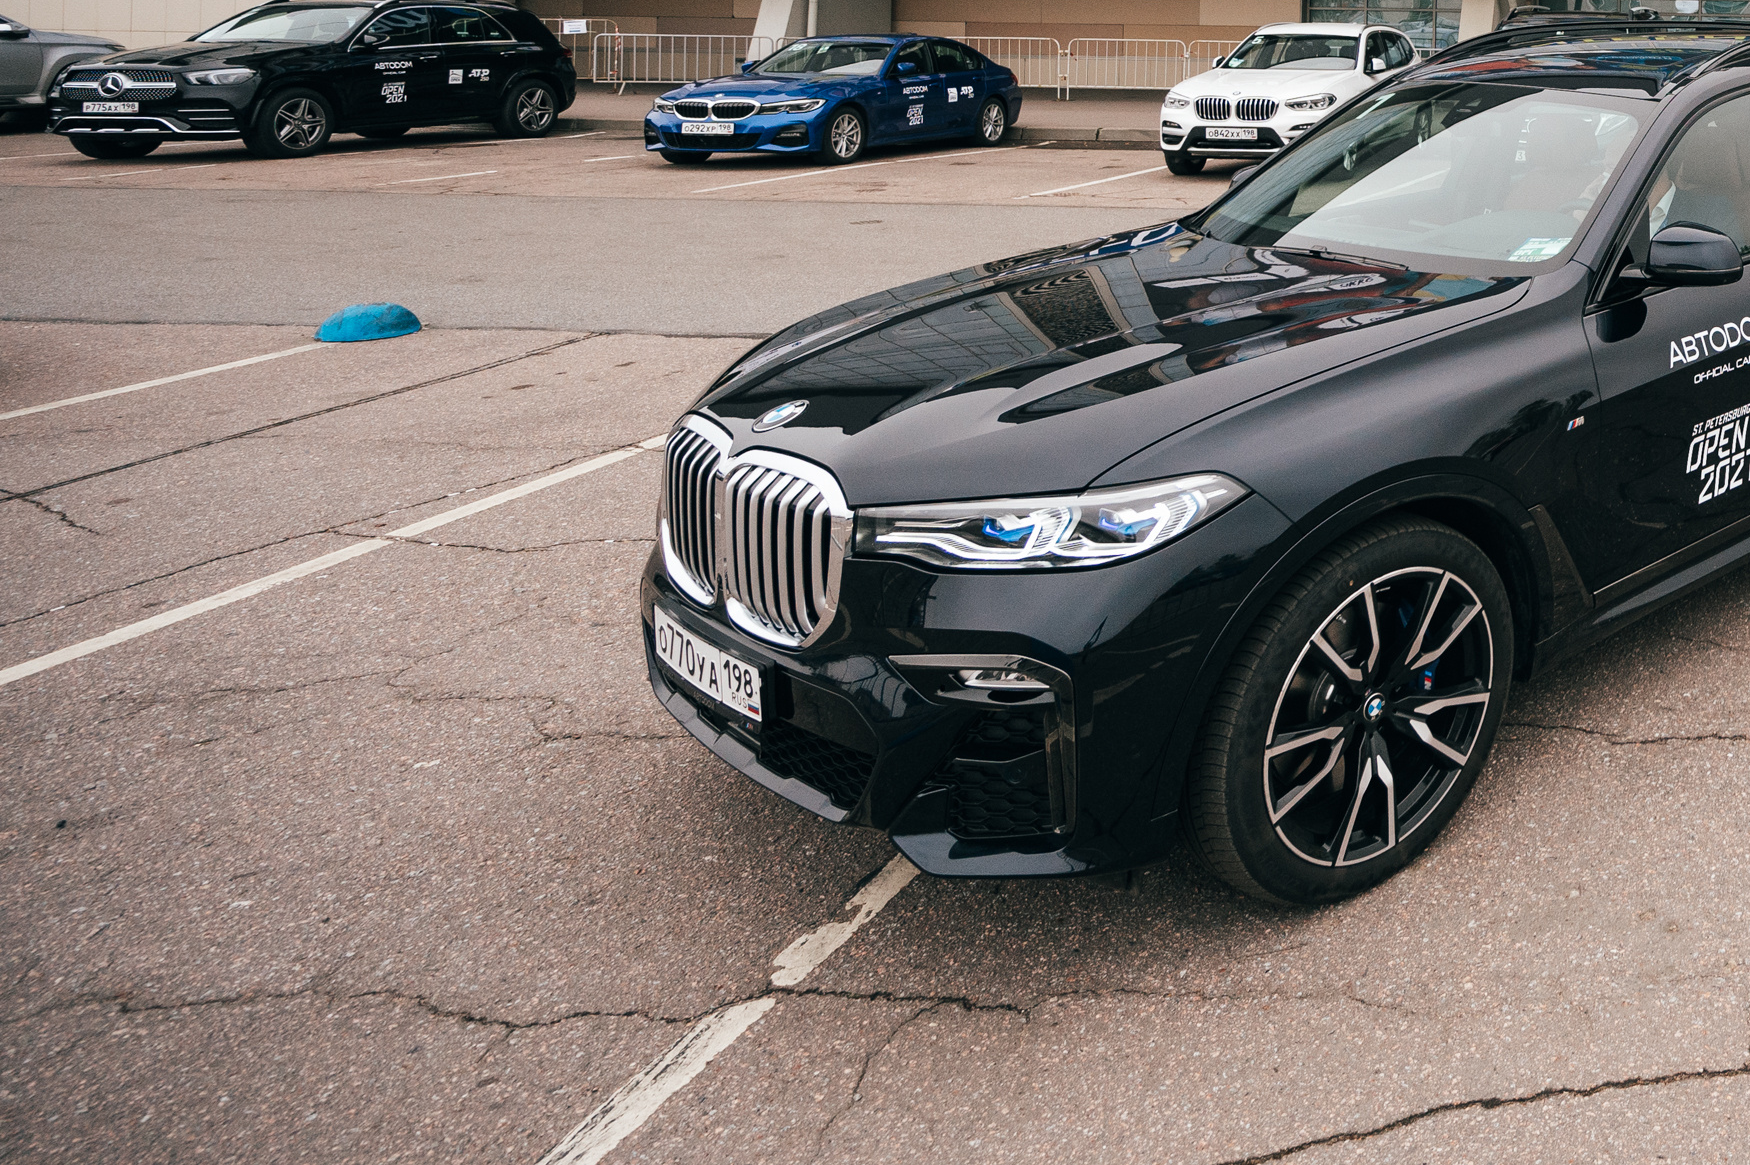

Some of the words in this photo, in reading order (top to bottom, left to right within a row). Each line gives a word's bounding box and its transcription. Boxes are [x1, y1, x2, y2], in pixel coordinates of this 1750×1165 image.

[468, 68, 490, 78] ATP
[381, 85, 405, 96] OPEN
[385, 94, 408, 104] 2021
[1693, 362, 1735, 384] OFFICIAL
[1692, 422, 1703, 437] ST.
[1685, 415, 1750, 474] OPEN
[723, 659, 754, 699] 198
[731, 691, 748, 710] RUS
